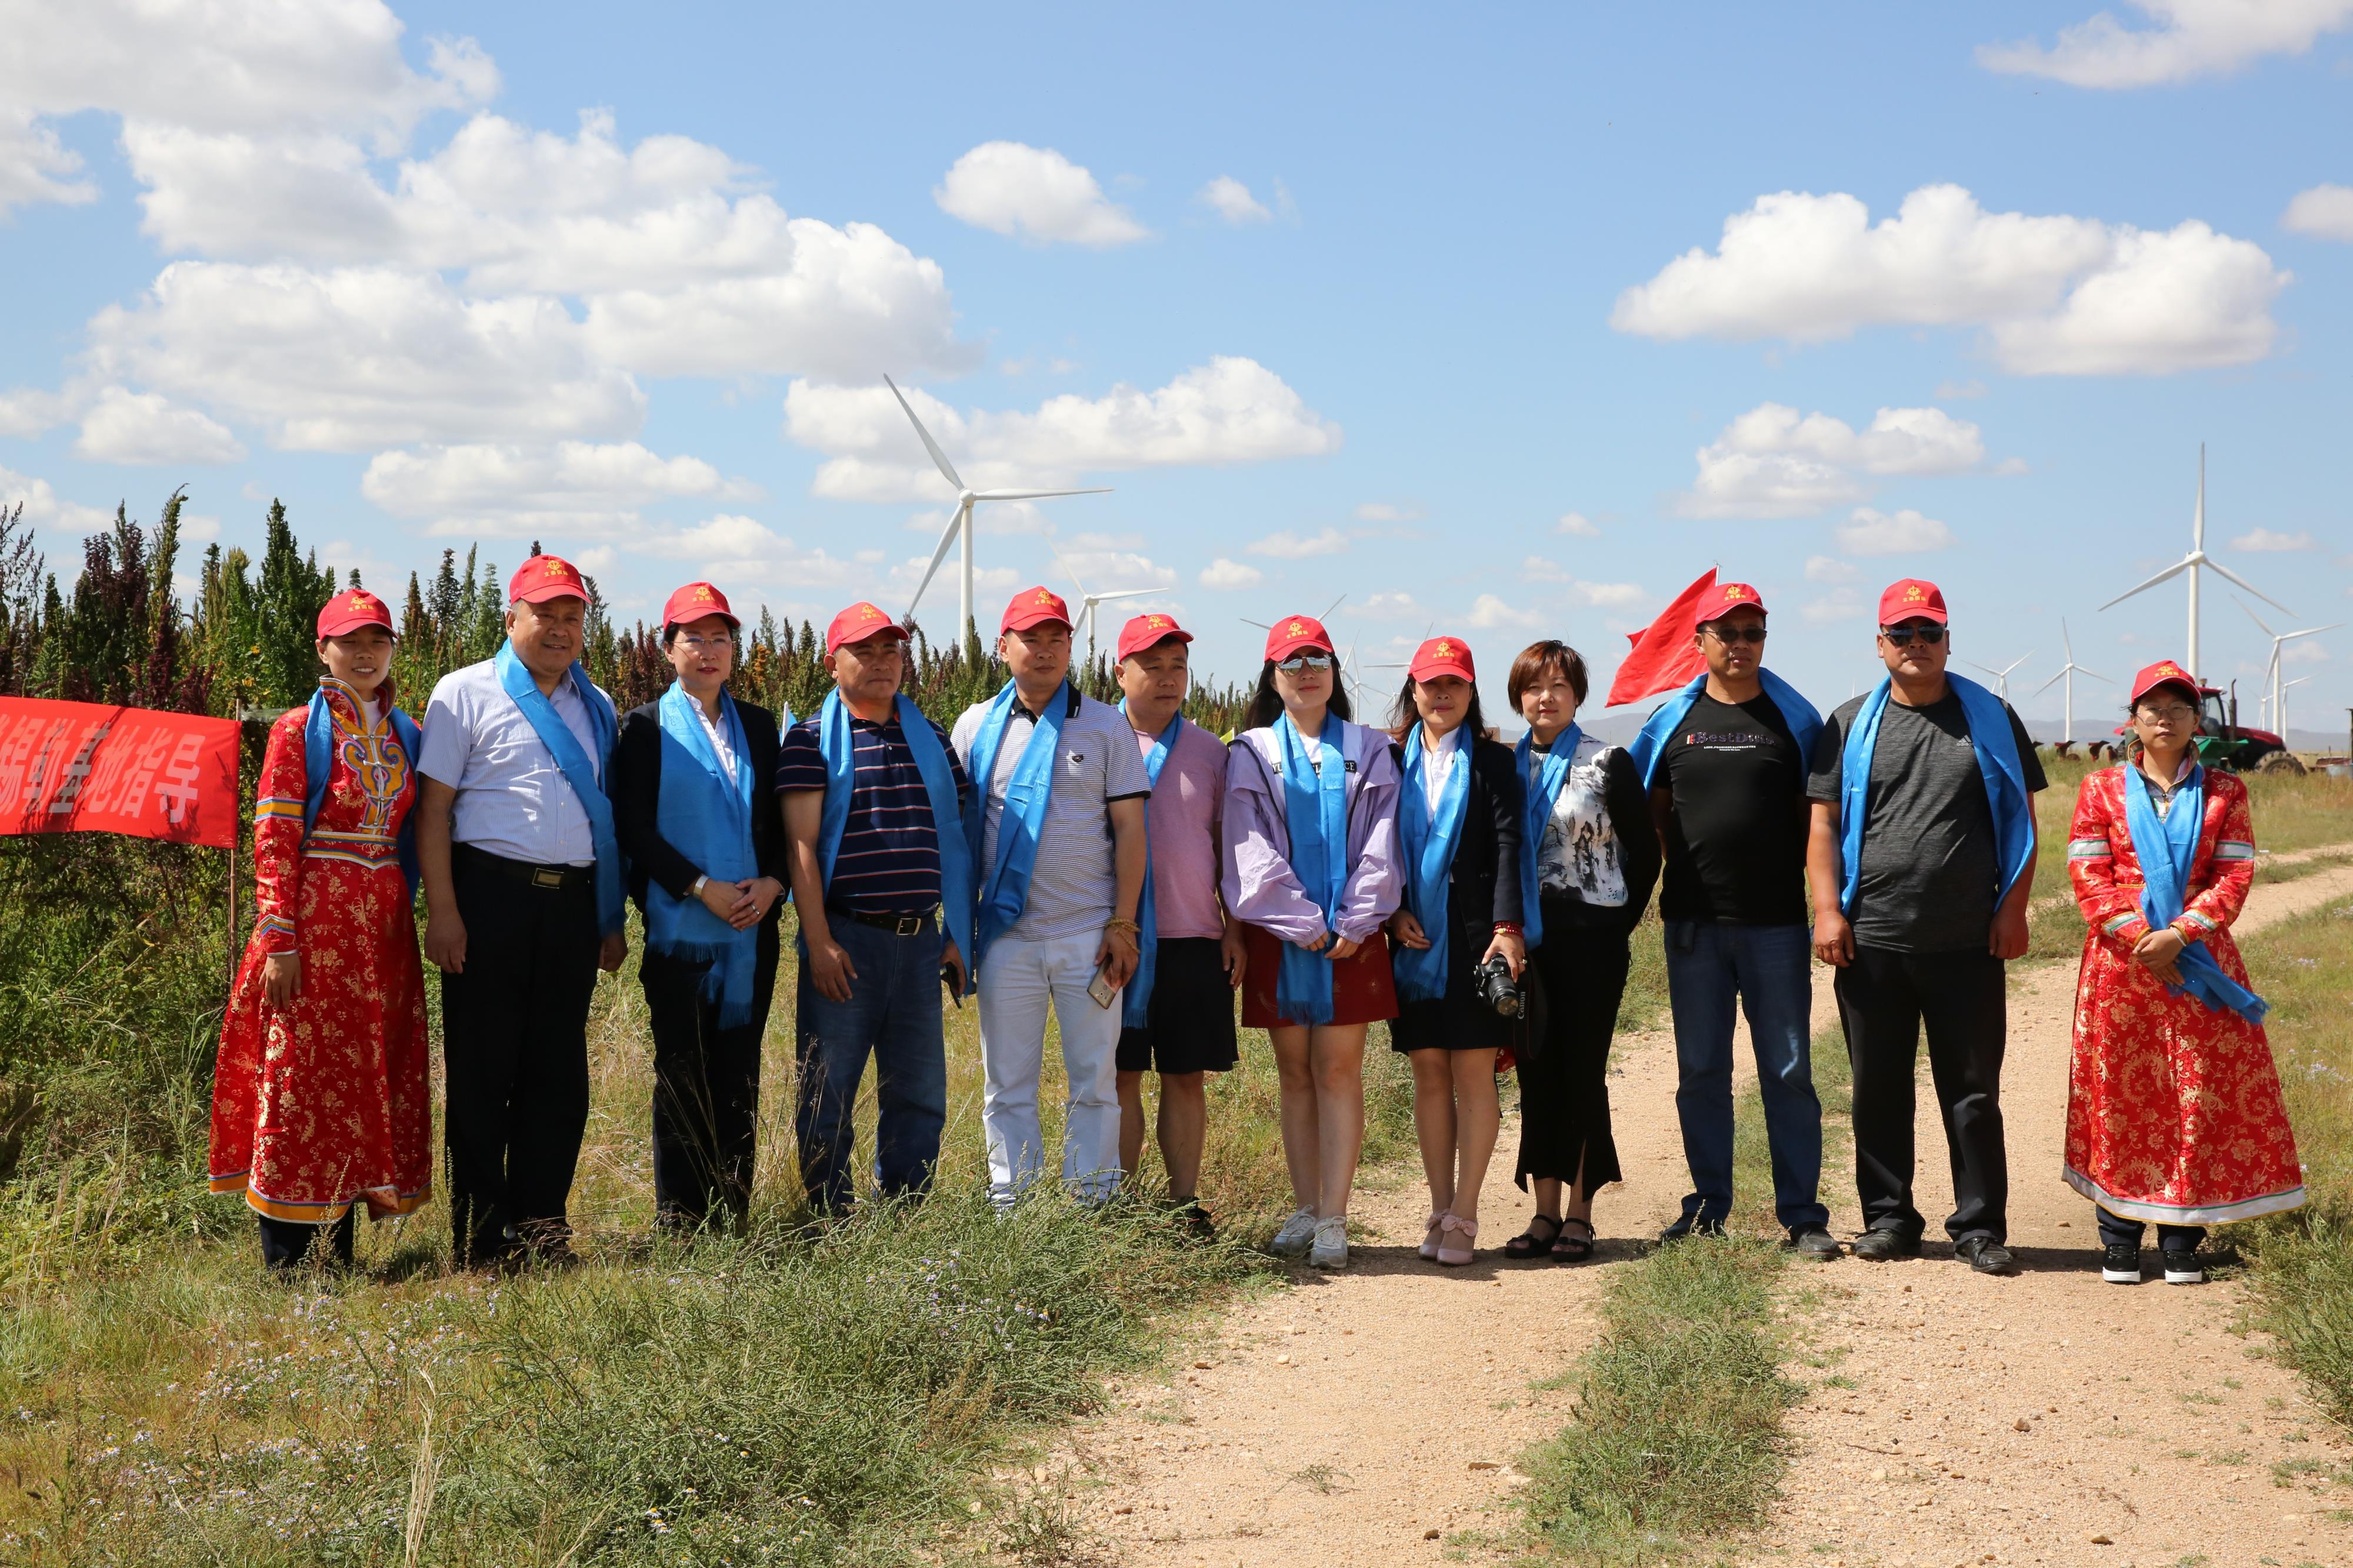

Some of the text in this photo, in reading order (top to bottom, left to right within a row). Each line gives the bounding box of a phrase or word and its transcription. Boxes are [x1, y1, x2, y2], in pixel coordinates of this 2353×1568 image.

[0, 714, 206, 823] 锡勒基地指导
[1518, 991, 1526, 1019] Canon
